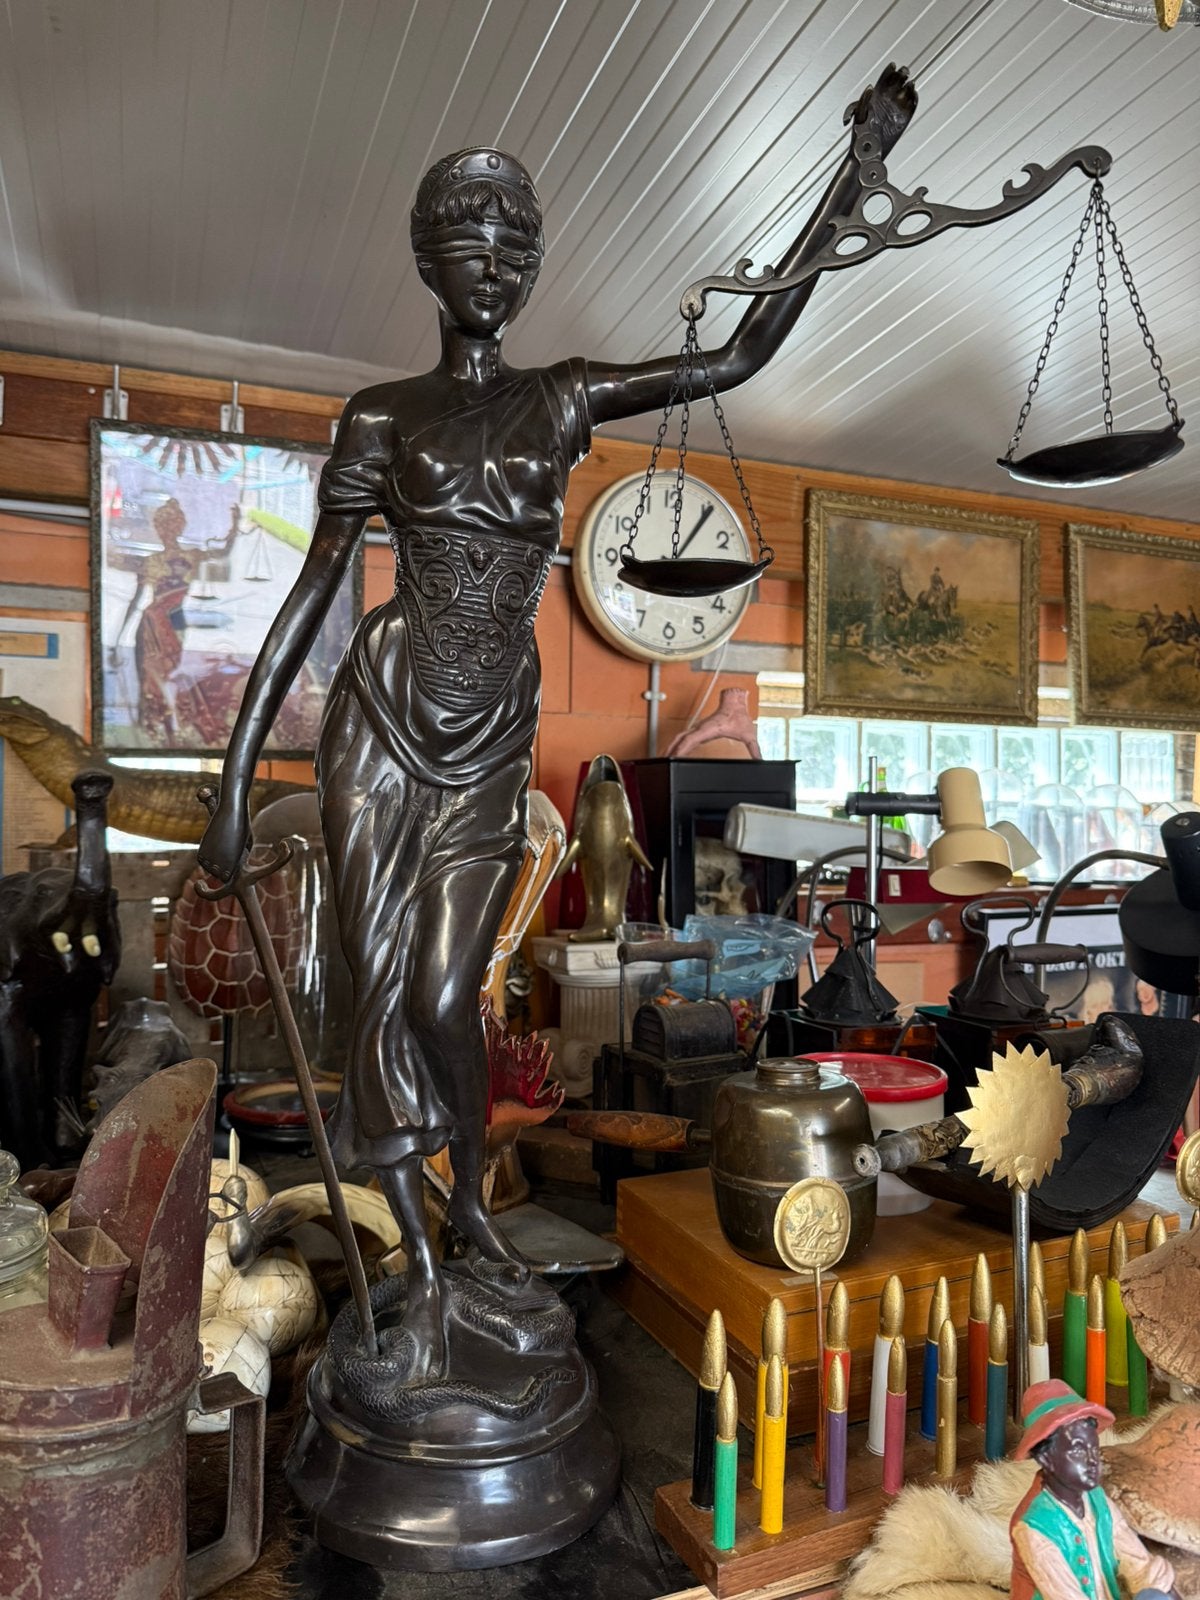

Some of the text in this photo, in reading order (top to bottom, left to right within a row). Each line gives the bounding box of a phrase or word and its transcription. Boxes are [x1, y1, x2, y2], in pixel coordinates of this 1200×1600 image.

[615, 515, 634, 534] 10
[716, 530, 730, 550] 2
[605, 548, 618, 566] 9
[711, 595, 726, 614] 4
[636, 609, 646, 628] 7
[692, 616, 705, 634] 5
[662, 621, 676, 639] 6
